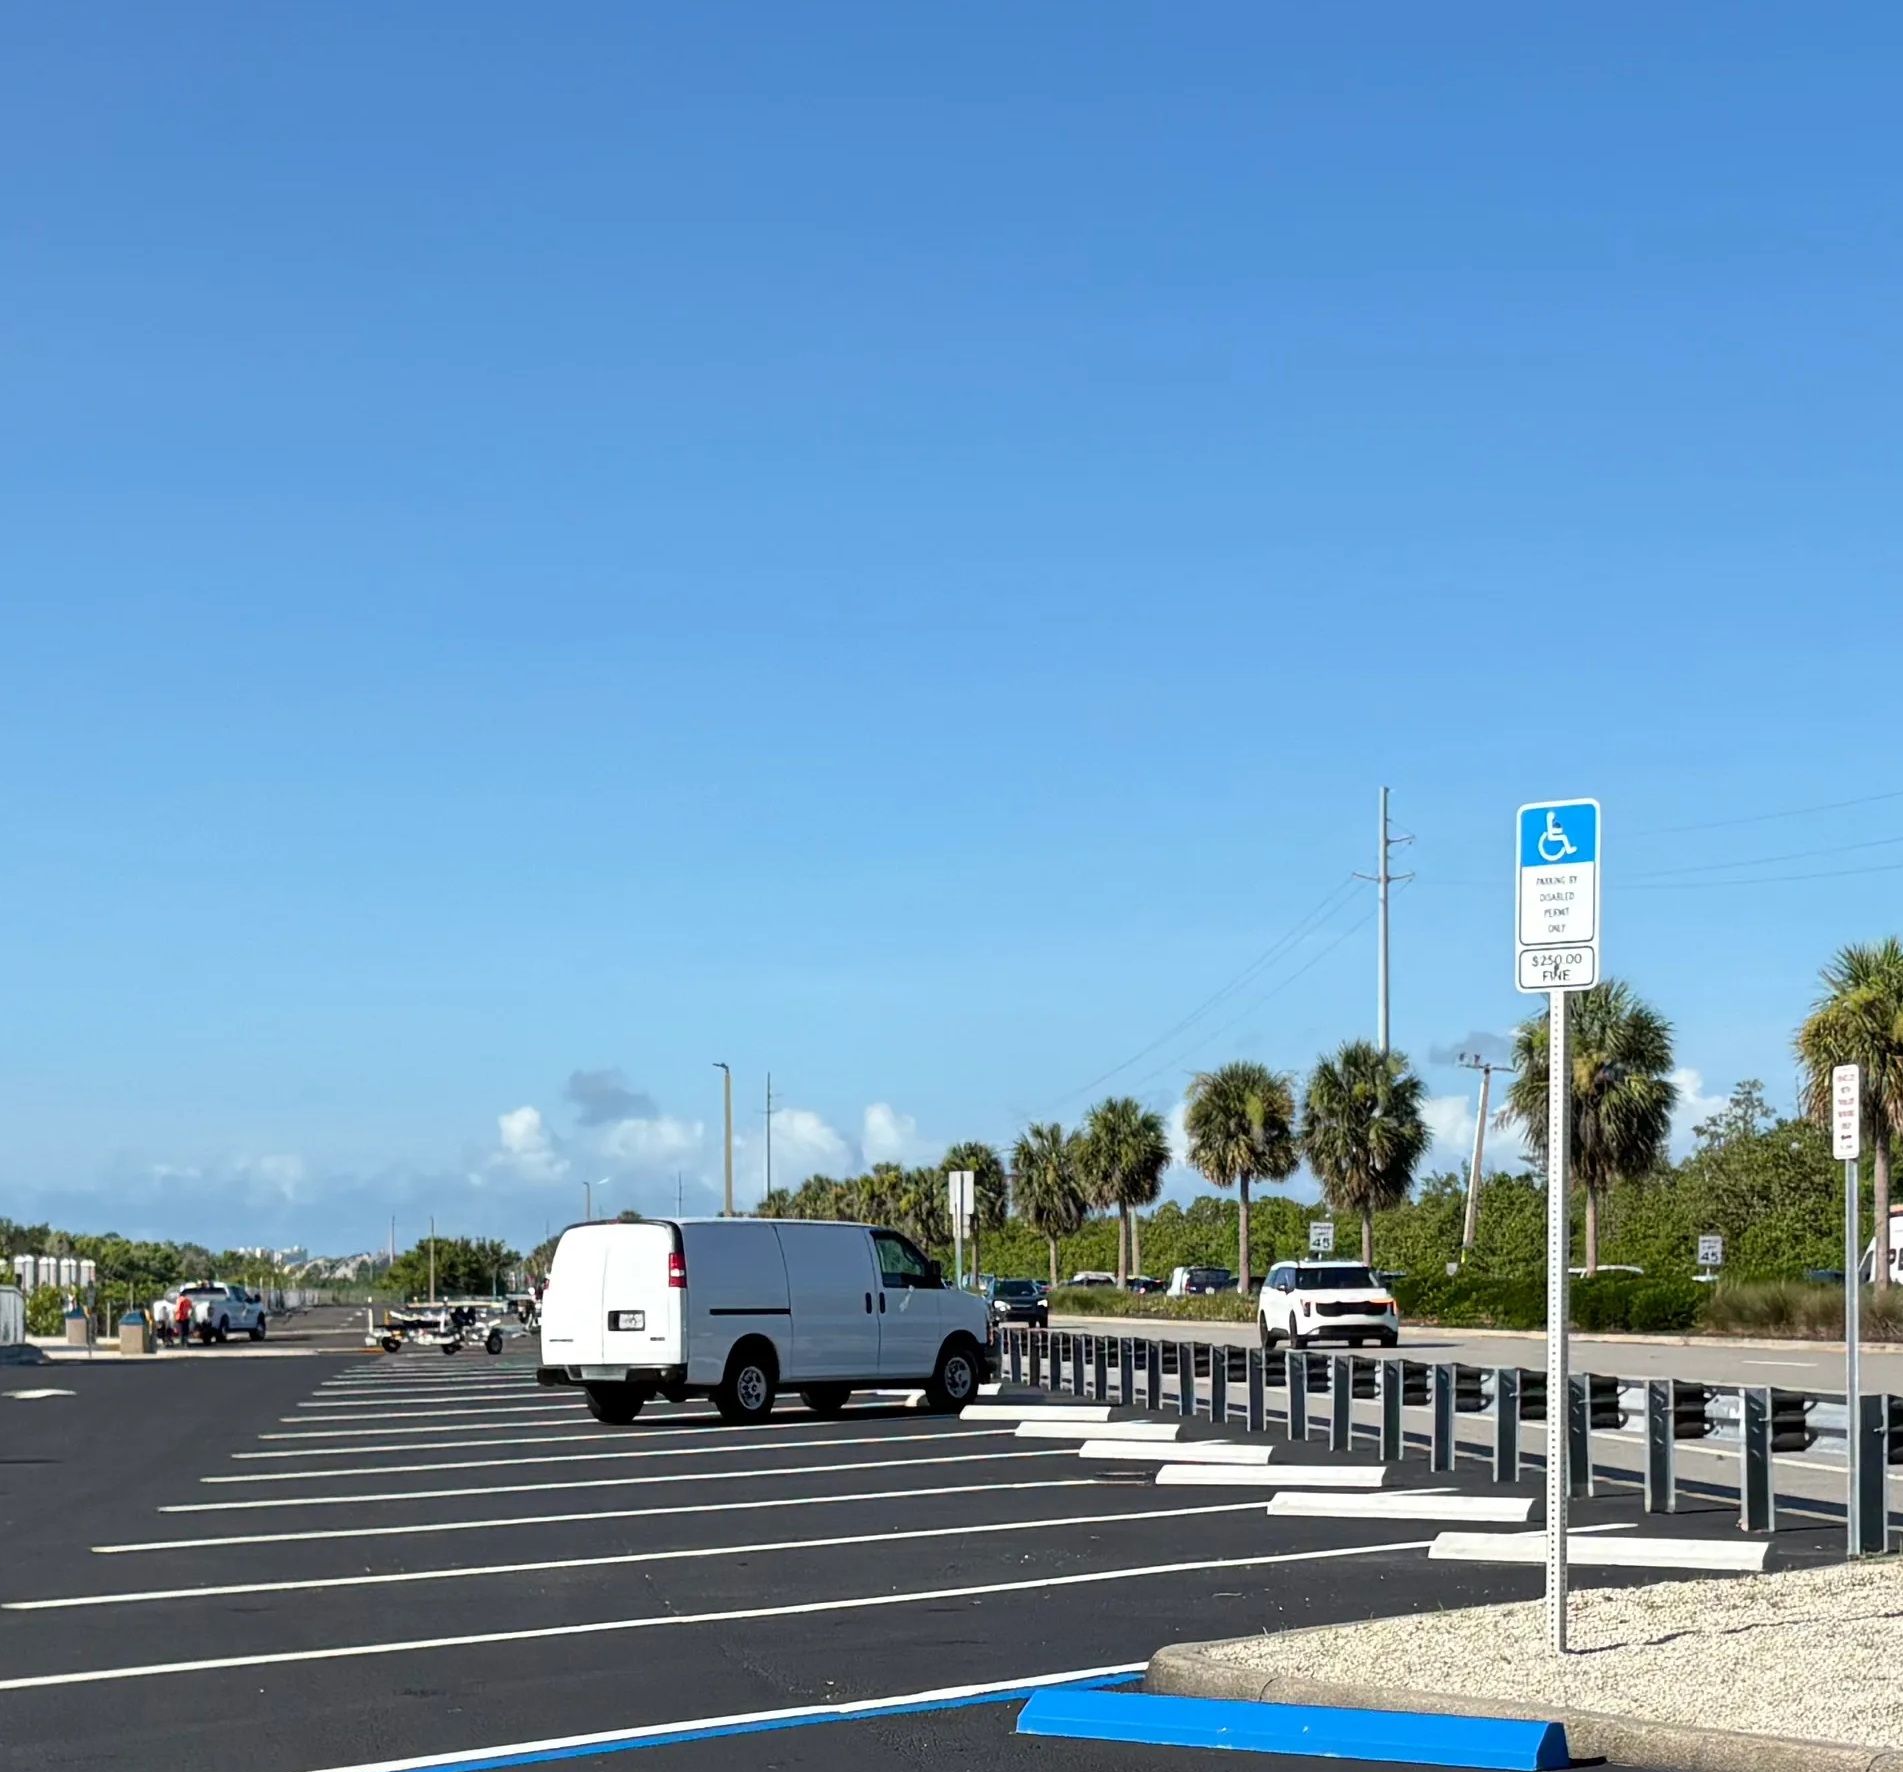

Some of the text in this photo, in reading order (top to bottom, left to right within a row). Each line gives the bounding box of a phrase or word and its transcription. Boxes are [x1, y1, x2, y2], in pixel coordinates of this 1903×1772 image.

[1540, 892, 1575, 902] DISABLED
[1532, 953, 1582, 967] $250.00
[1542, 969, 1571, 982] FINE
